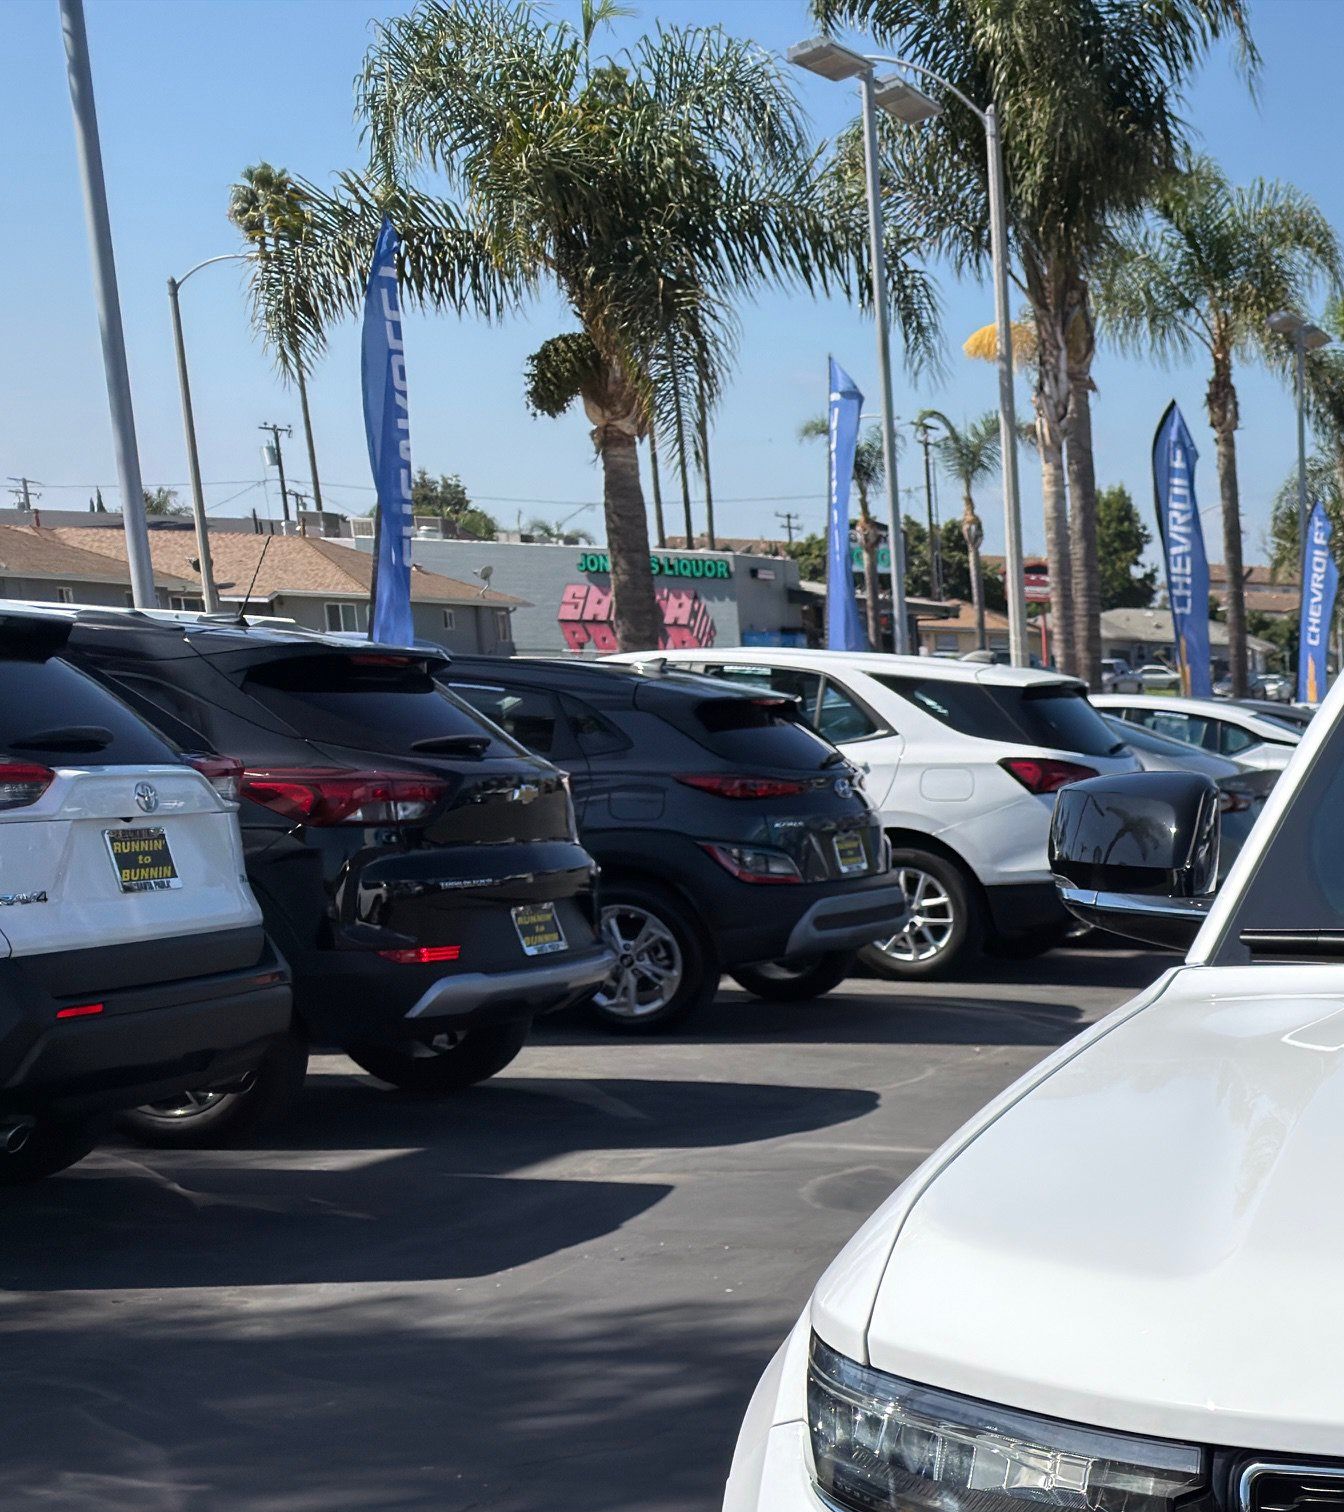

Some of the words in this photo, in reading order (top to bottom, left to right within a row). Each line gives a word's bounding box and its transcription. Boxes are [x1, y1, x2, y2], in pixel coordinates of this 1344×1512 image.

[664, 556, 731, 579] LIQUOR
[112, 839, 165, 853] RUNNIN'
[138, 854, 152, 863] to
[121, 866, 172, 881] BUNNIN
